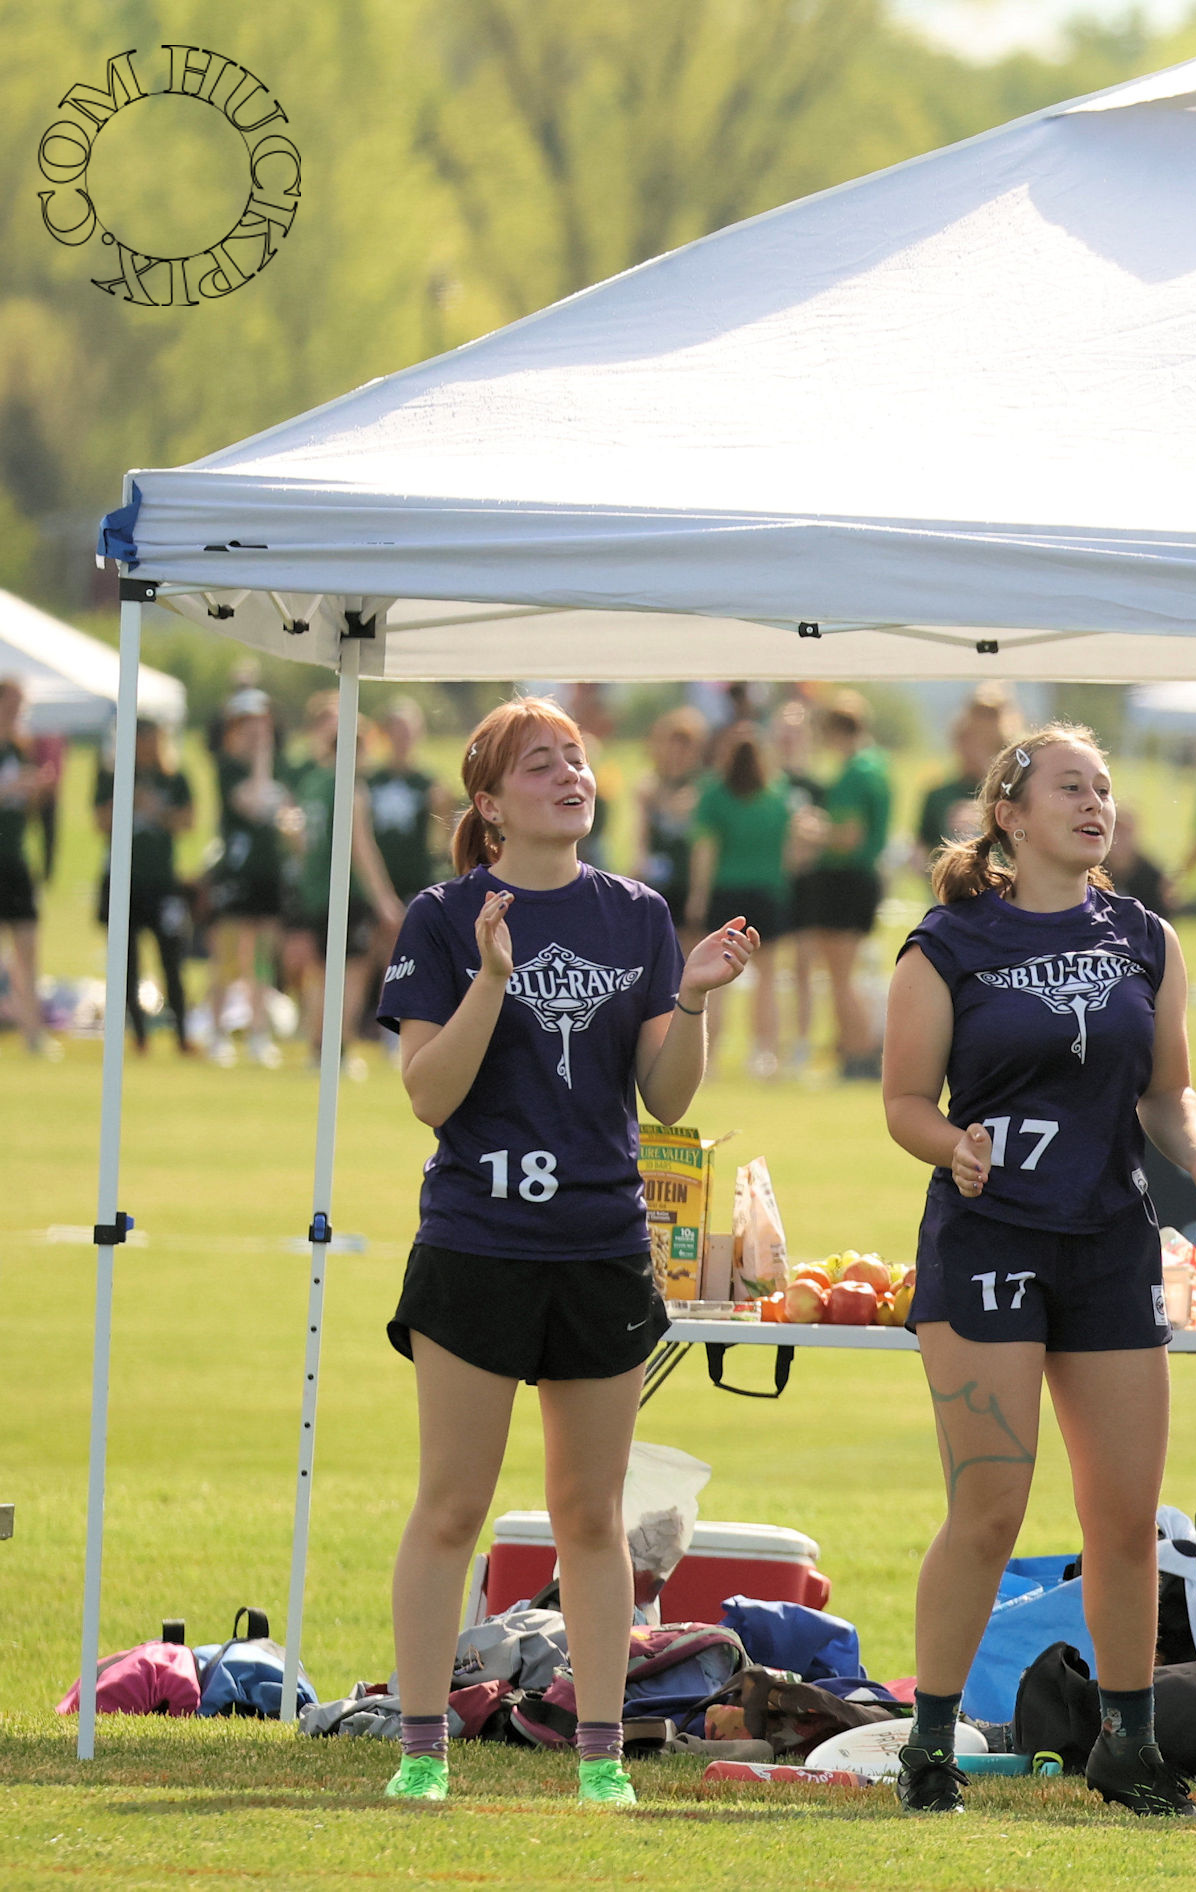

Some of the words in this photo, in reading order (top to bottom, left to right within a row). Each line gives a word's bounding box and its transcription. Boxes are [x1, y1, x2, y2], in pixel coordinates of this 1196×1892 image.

[384, 955, 416, 983] pin
[505, 969, 616, 1000] BLU-RAY
[1010, 956, 1124, 990] BLU-RAY
[662, 1148, 700, 1168] VALLEY
[982, 1116, 1060, 1171] 17
[479, 1149, 559, 1203] 18
[646, 1179, 688, 1204] OTEIN
[971, 1270, 1037, 1312] 17
